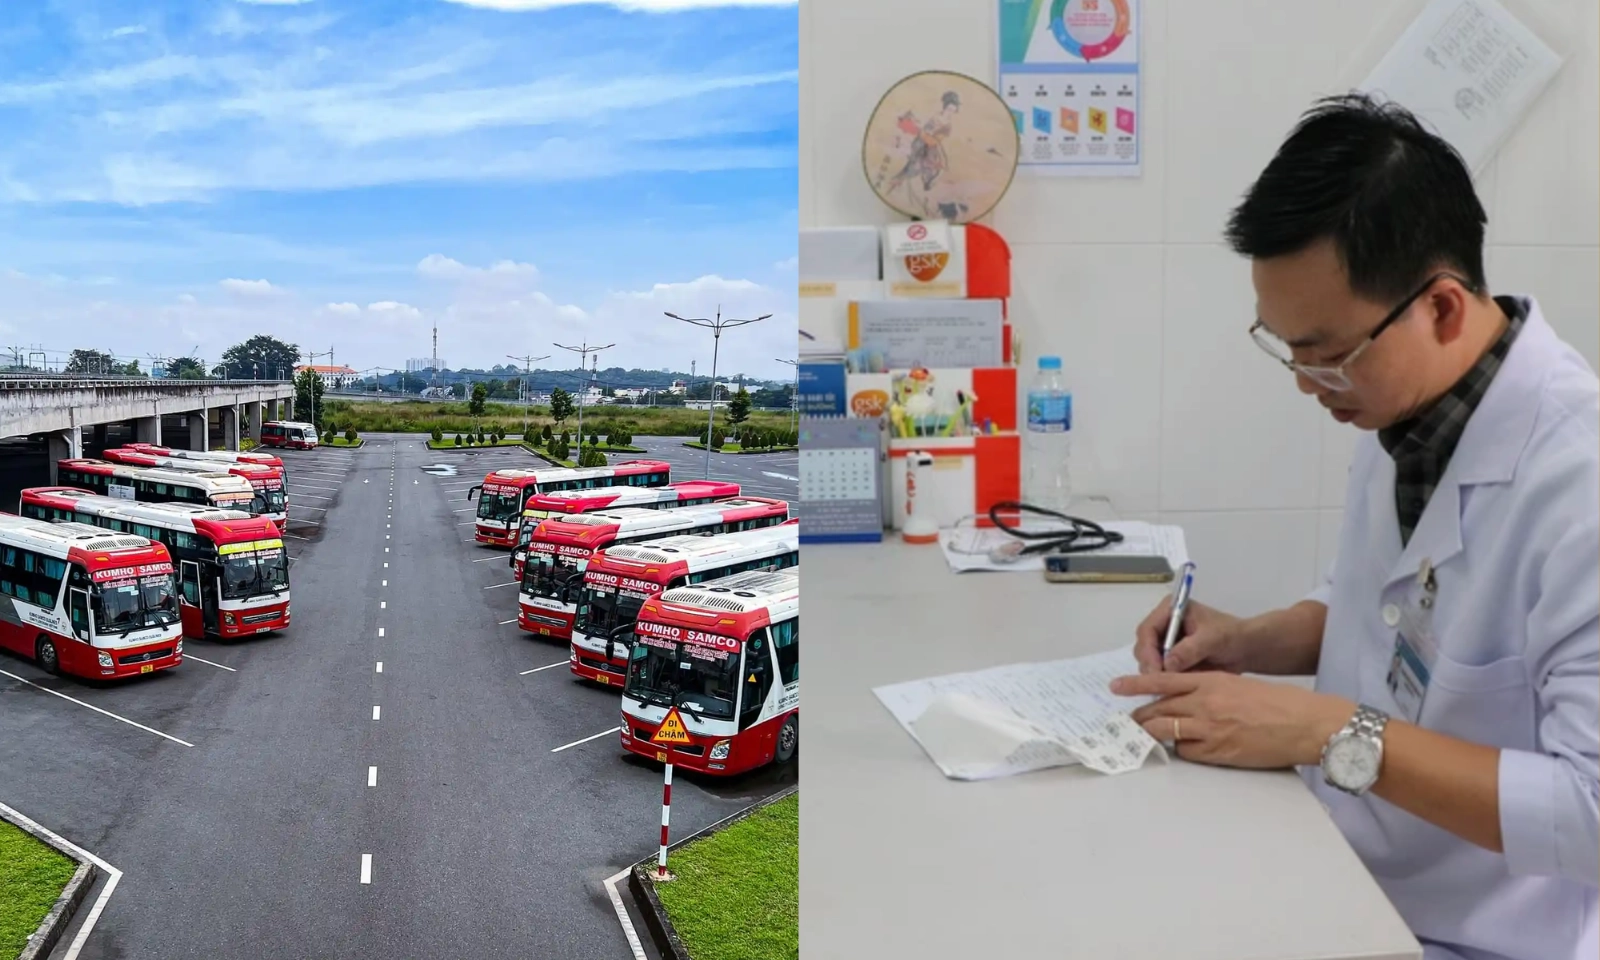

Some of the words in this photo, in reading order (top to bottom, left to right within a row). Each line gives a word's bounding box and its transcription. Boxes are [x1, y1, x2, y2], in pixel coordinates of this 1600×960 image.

[530, 542, 555, 551] KUMHO
[559, 545, 590, 556] SAMCO
[96, 567, 134, 579] KUMHO
[140, 562, 172, 573] SAMCO
[585, 571, 617, 583] KUMHO
[622, 577, 659, 591] SAMCO
[637, 621, 680, 637] KUMHO
[687, 630, 736, 648] SAMCO
[658, 729, 685, 739] CHẬM
